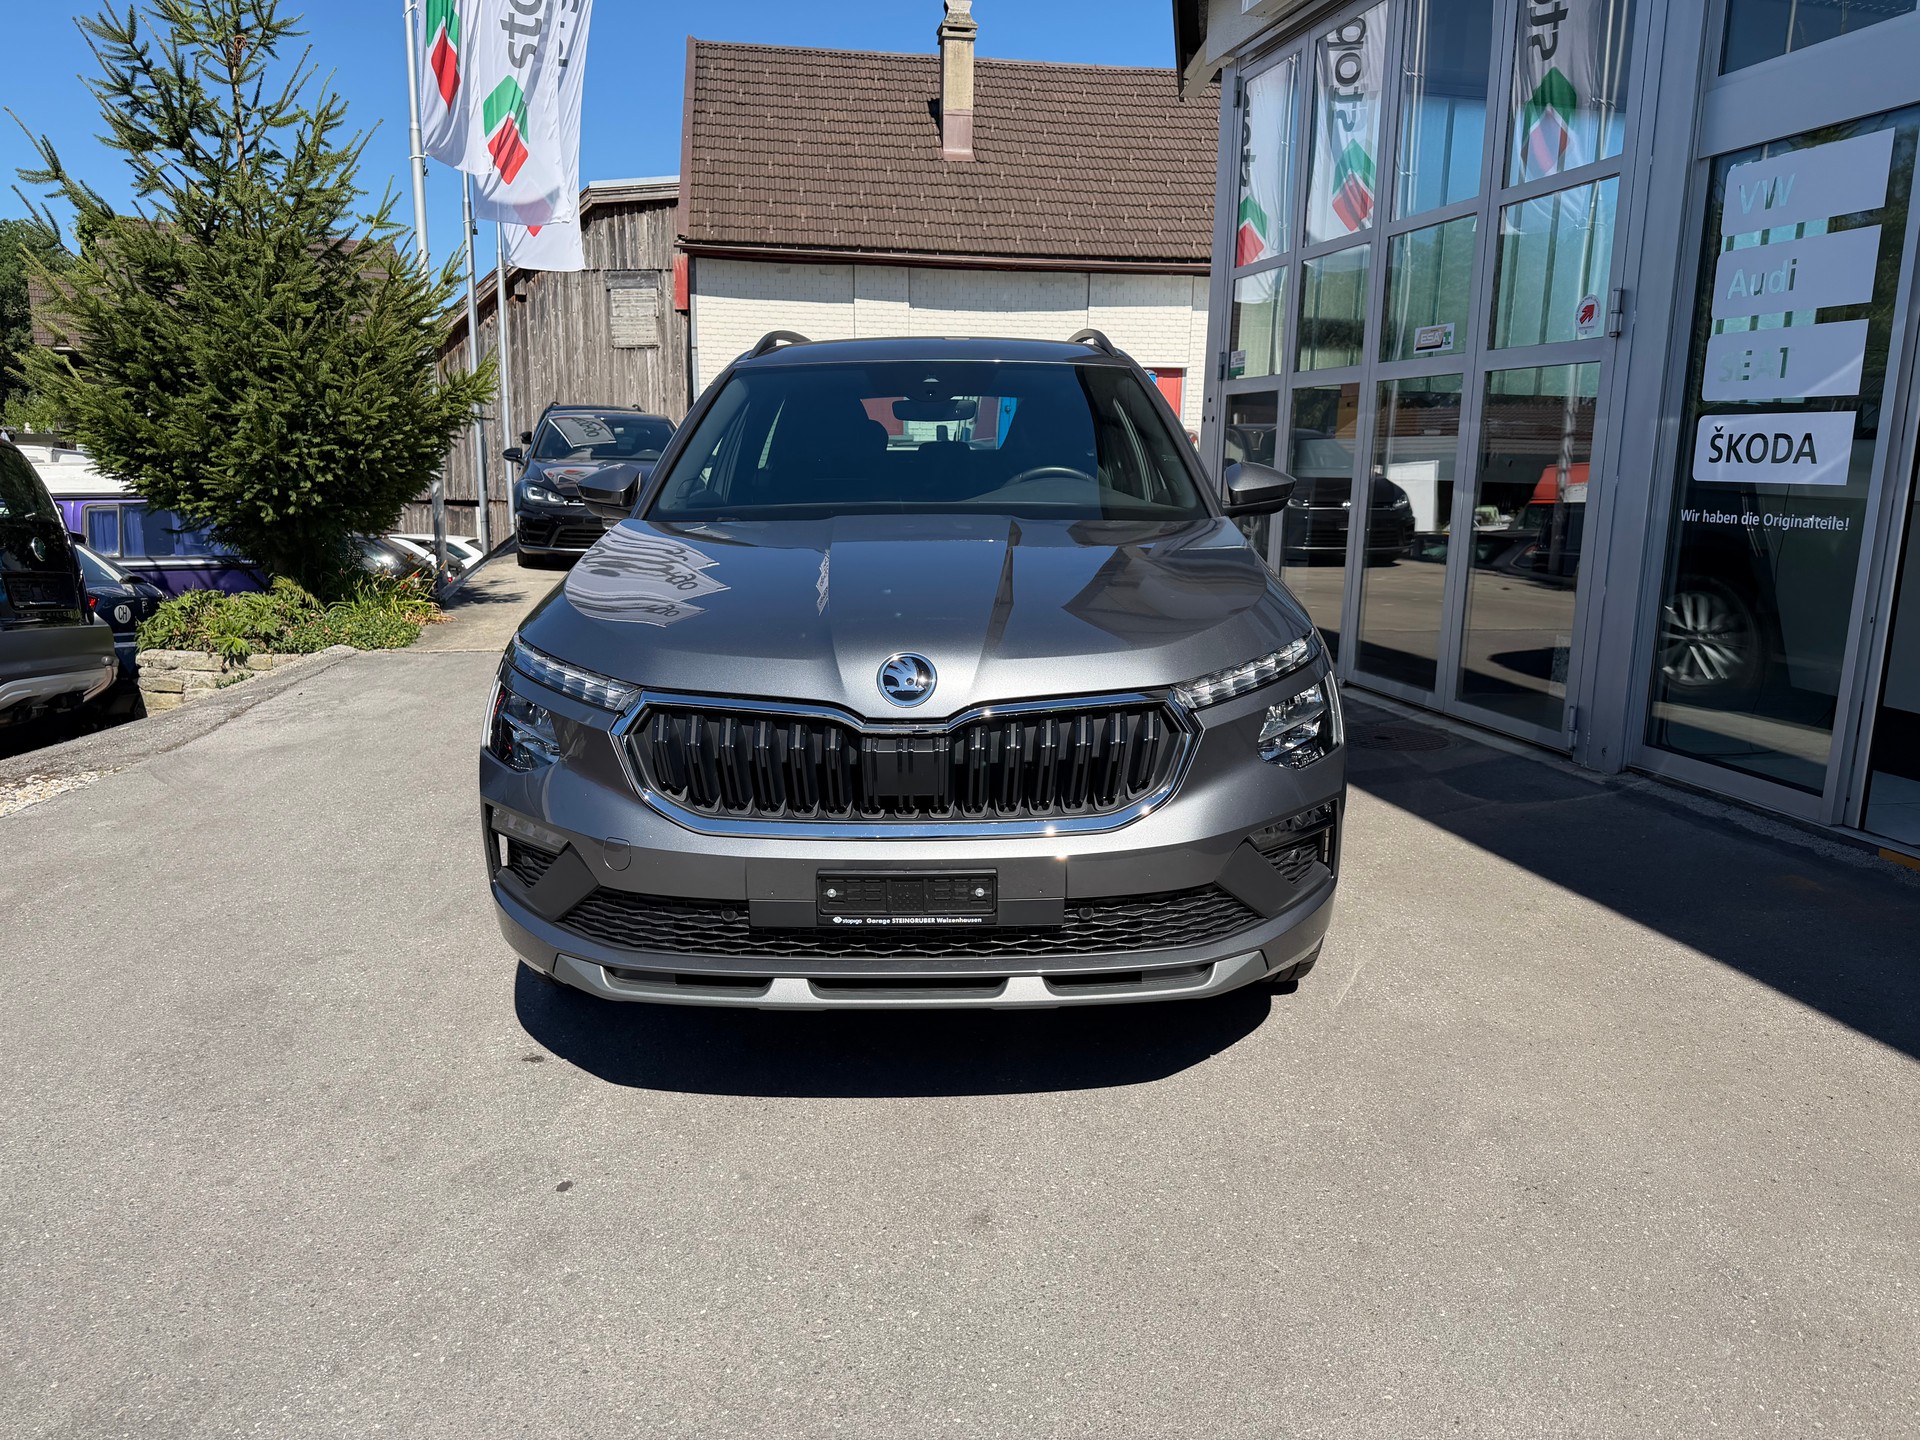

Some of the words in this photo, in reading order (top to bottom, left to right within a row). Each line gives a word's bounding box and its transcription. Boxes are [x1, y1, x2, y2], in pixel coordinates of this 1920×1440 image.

[1739, 173, 1796, 215] VW
[1727, 258, 1798, 300] Audi
[1421, 332, 1440, 345] ESA
[1708, 425, 1818, 465] ŠKODA
[1680, 509, 1700, 523] Wir
[1702, 510, 1738, 525] haben
[1741, 512, 1760, 527] die
[1763, 513, 1850, 532] Originalteile!
[118, 606, 128, 621] CH
[866, 917, 891, 925] Garage
